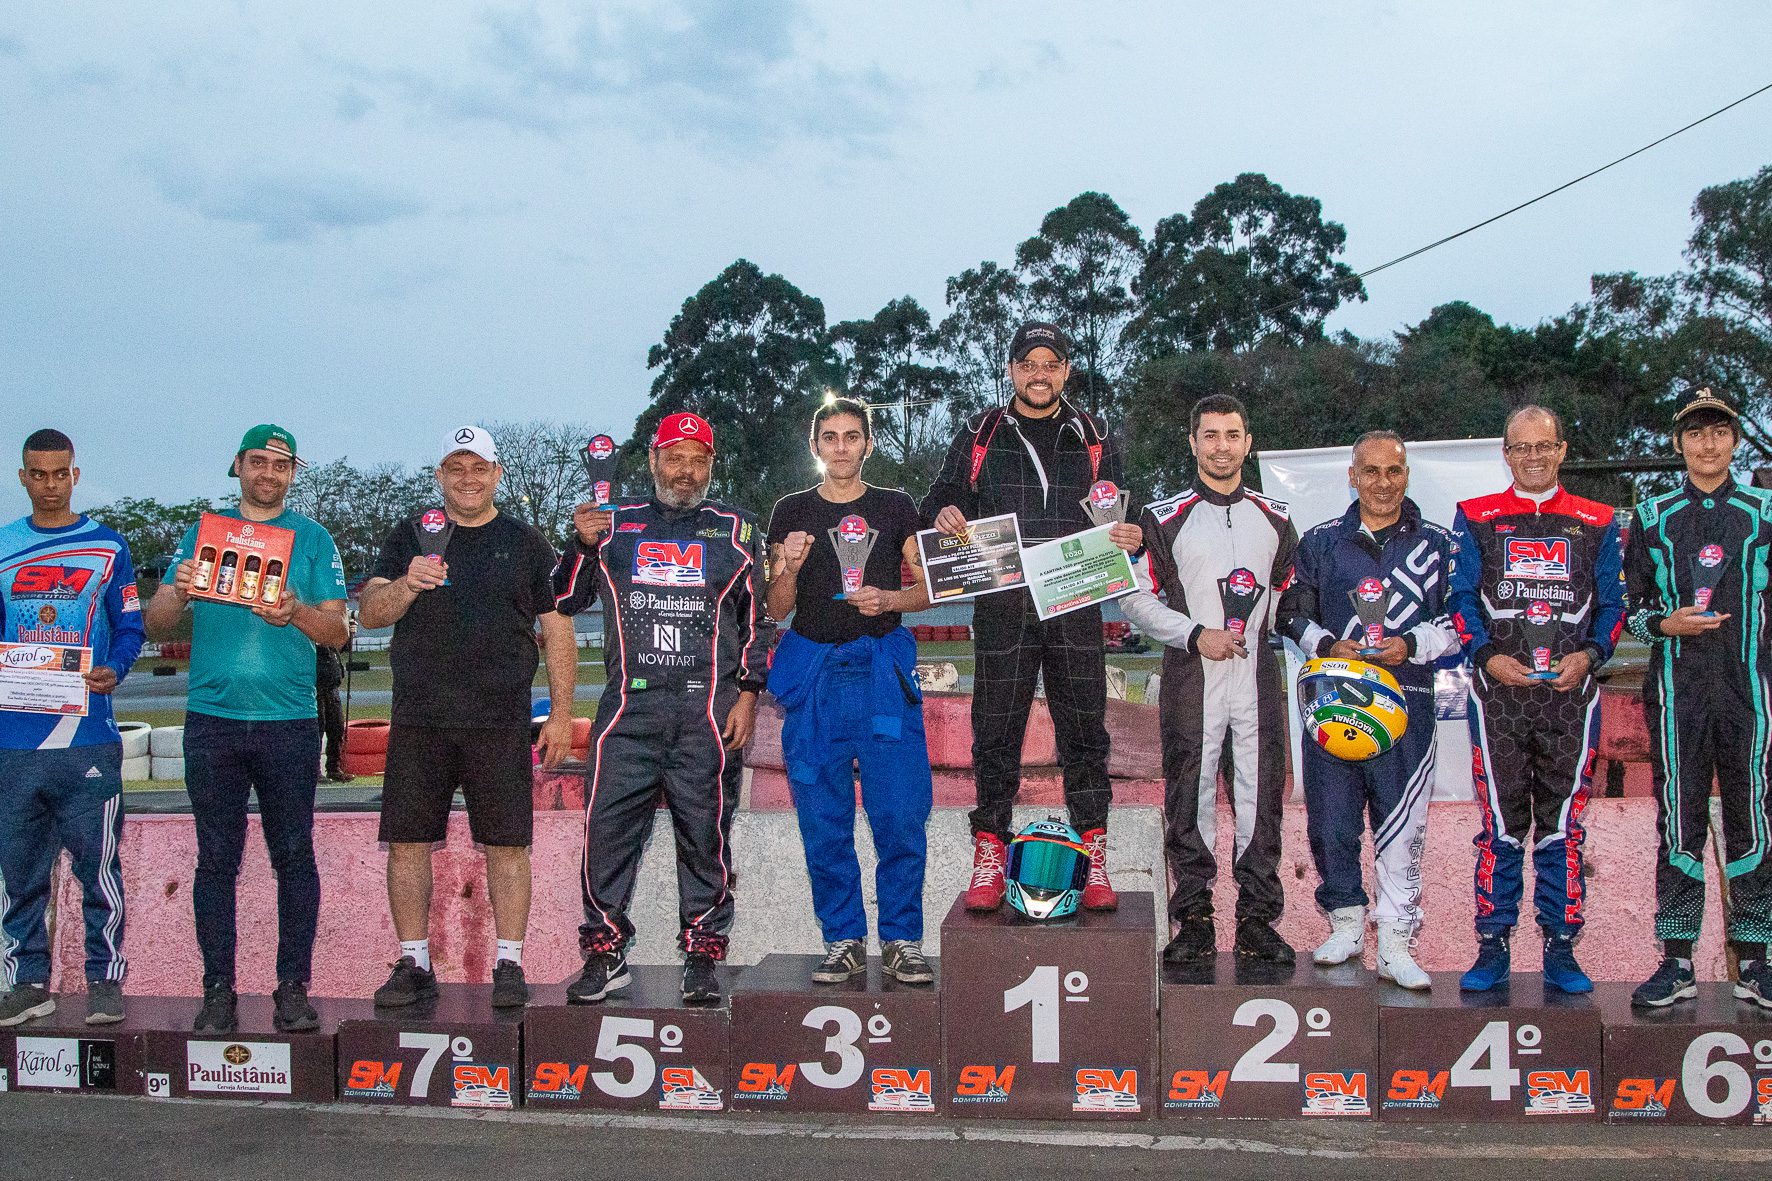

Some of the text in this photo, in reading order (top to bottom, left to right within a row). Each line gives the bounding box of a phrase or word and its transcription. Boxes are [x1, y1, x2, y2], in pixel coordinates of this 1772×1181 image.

[1156, 506, 1175, 516] OMP
[226, 532, 266, 549] Paulistânia
[943, 532, 996, 547] Sky Pizza
[1509, 540, 1566, 564] SM
[637, 542, 702, 569] SM
[1065, 549, 1083, 559] 1020
[12, 565, 94, 594] SM
[1516, 582, 1574, 601] Paulistânia
[648, 594, 705, 612] Paulistânia
[18, 624, 80, 643] Paulistânia
[5, 647, 49, 665] Karol
[638, 653, 696, 666] NOVITART
[1334, 714, 1374, 735] NACIONAL
[18, 1049, 79, 1078] Karol 97
[189, 1063, 287, 1084] Paulistânia
[348, 1060, 402, 1089] SM
[454, 1065, 510, 1092] SM
[533, 1062, 589, 1092] SM
[738, 1062, 797, 1092] SM
[872, 1068, 931, 1095] SM
[956, 1065, 1016, 1095] SM
[1076, 1068, 1137, 1095] SM
[1168, 1070, 1230, 1100] SM
[1305, 1072, 1367, 1098] SM
[1388, 1070, 1450, 1100] SM
[1528, 1070, 1590, 1096] SM
[344, 1090, 395, 1098] COMPETITION
[1613, 1078, 1677, 1109] SM
